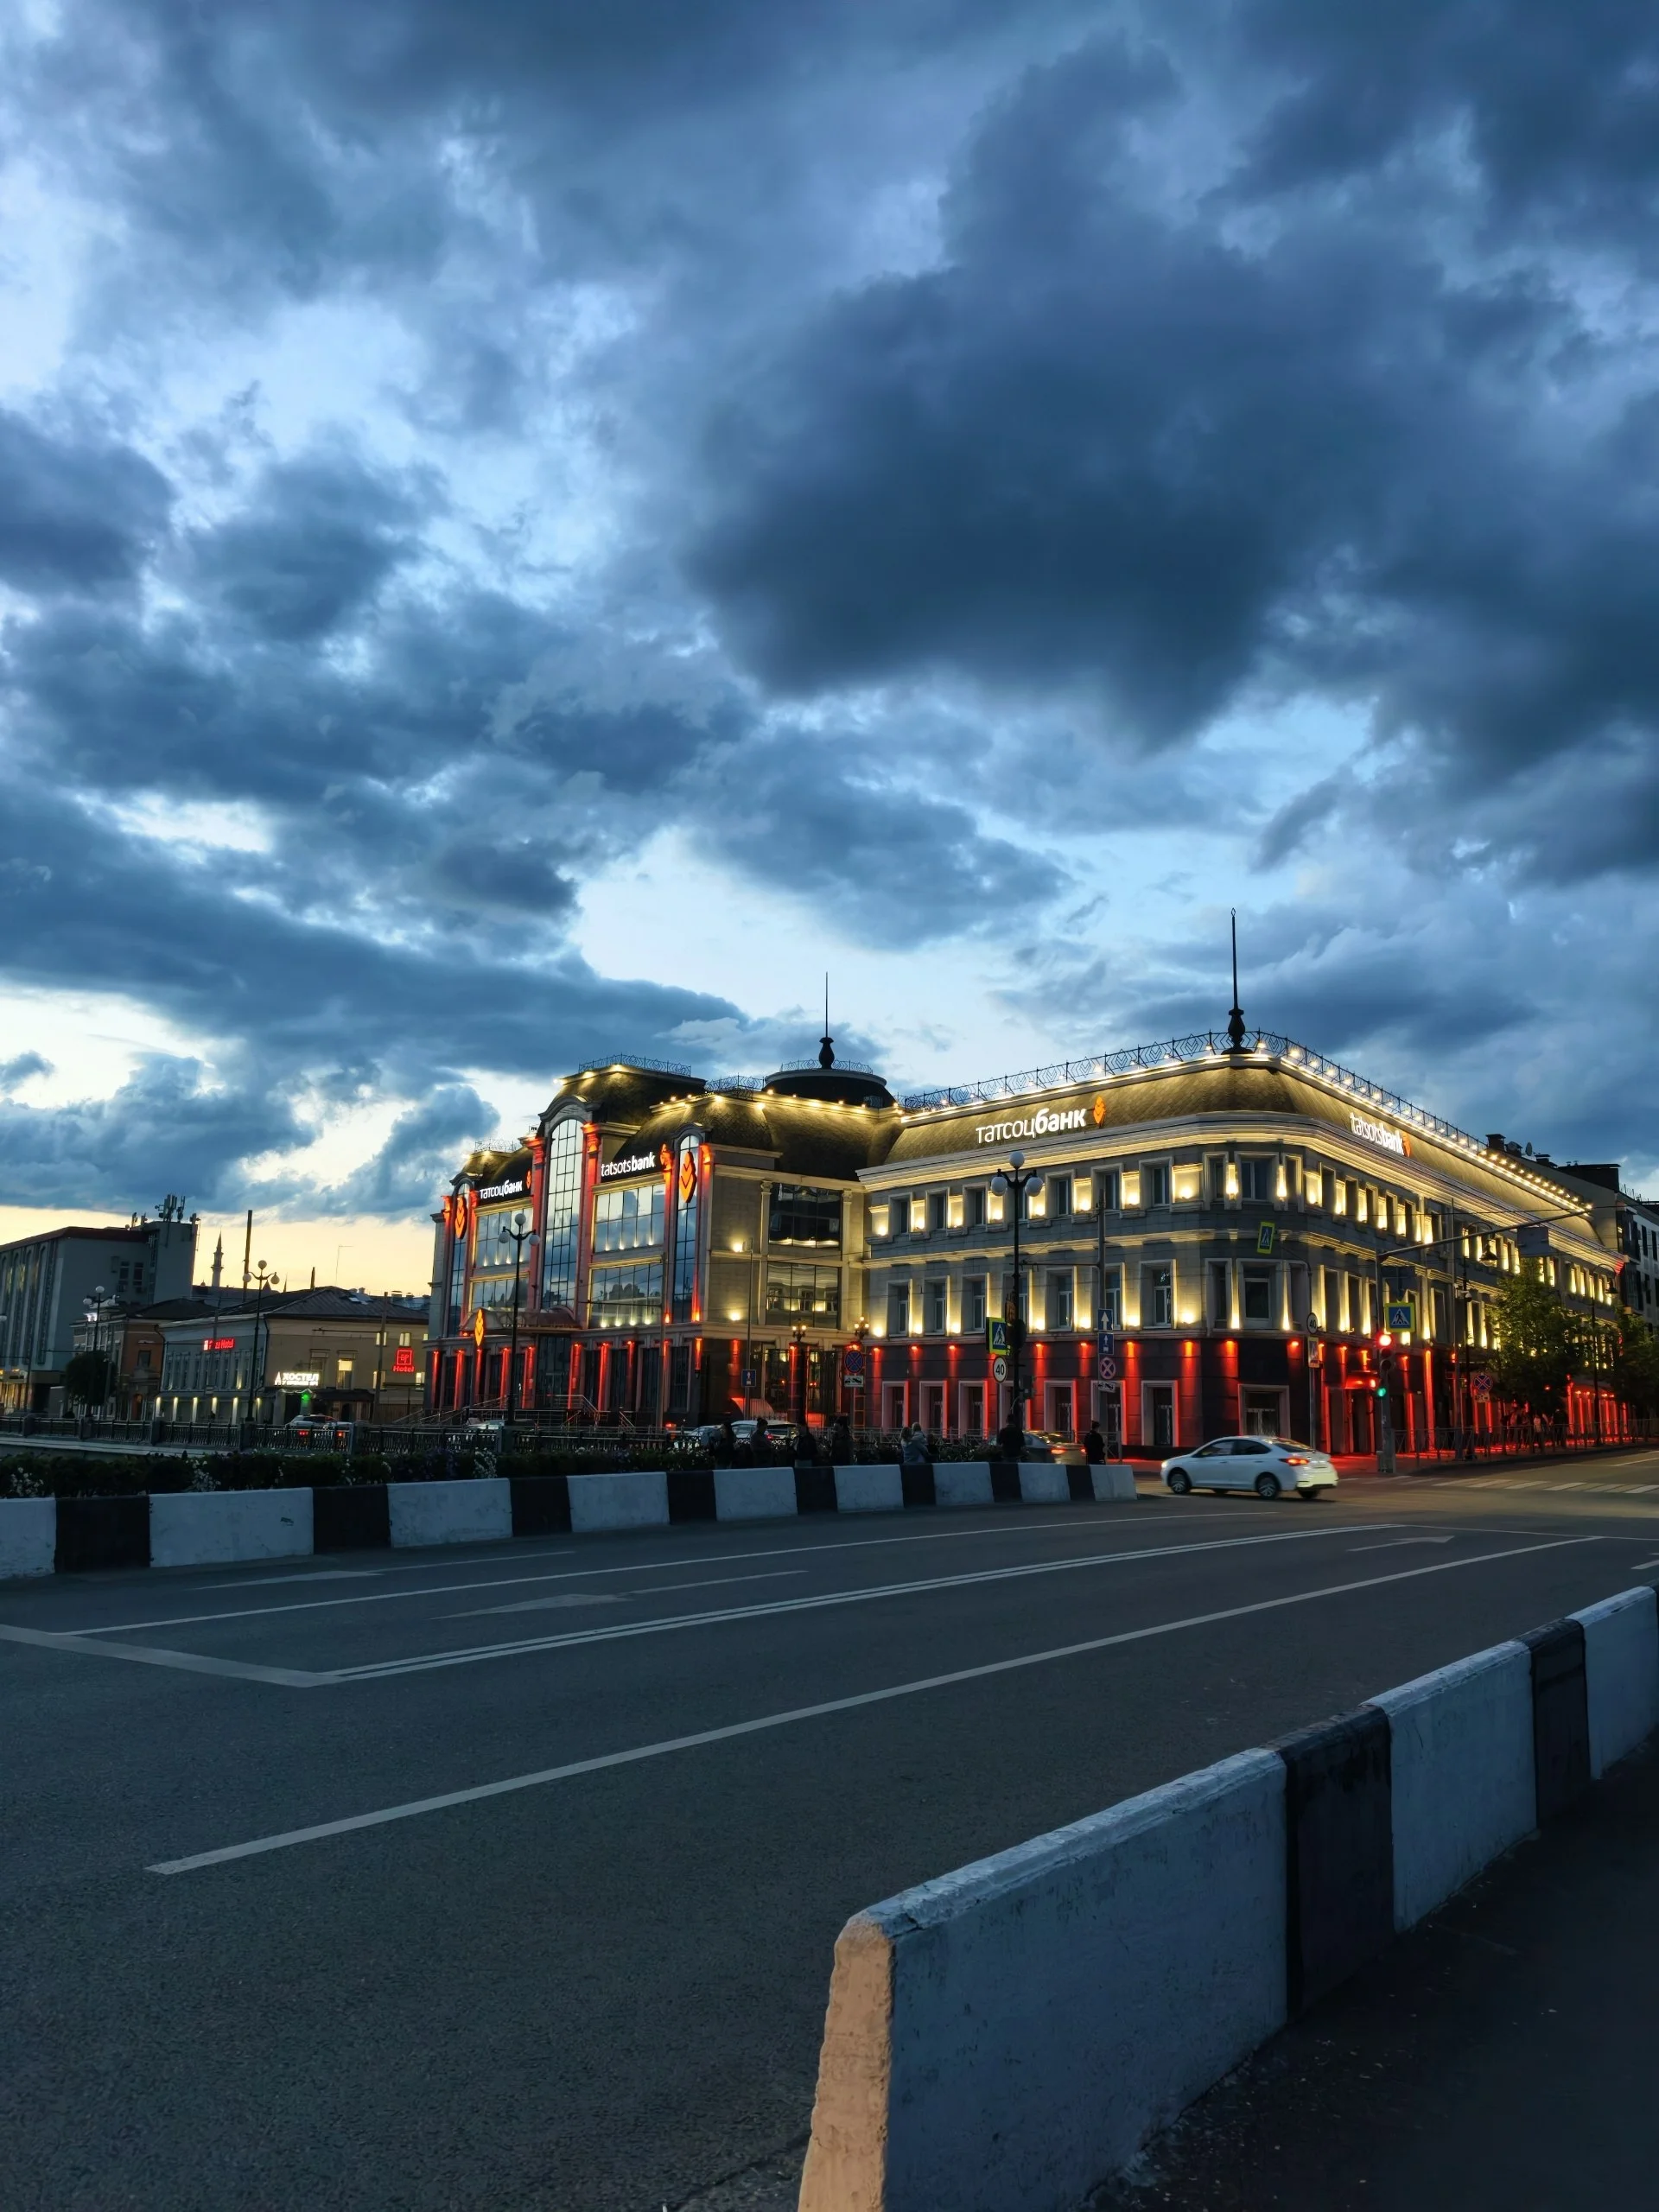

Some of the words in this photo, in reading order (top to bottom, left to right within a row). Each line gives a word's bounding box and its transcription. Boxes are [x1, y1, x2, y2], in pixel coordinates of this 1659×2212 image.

[1350, 1112, 1404, 1155] tatsotsbank
[601, 1152, 655, 1176] tatsotsbank
[283, 1372, 320, 1382] ХОСТЕЛ
[995, 1364, 1005, 1375] 40
